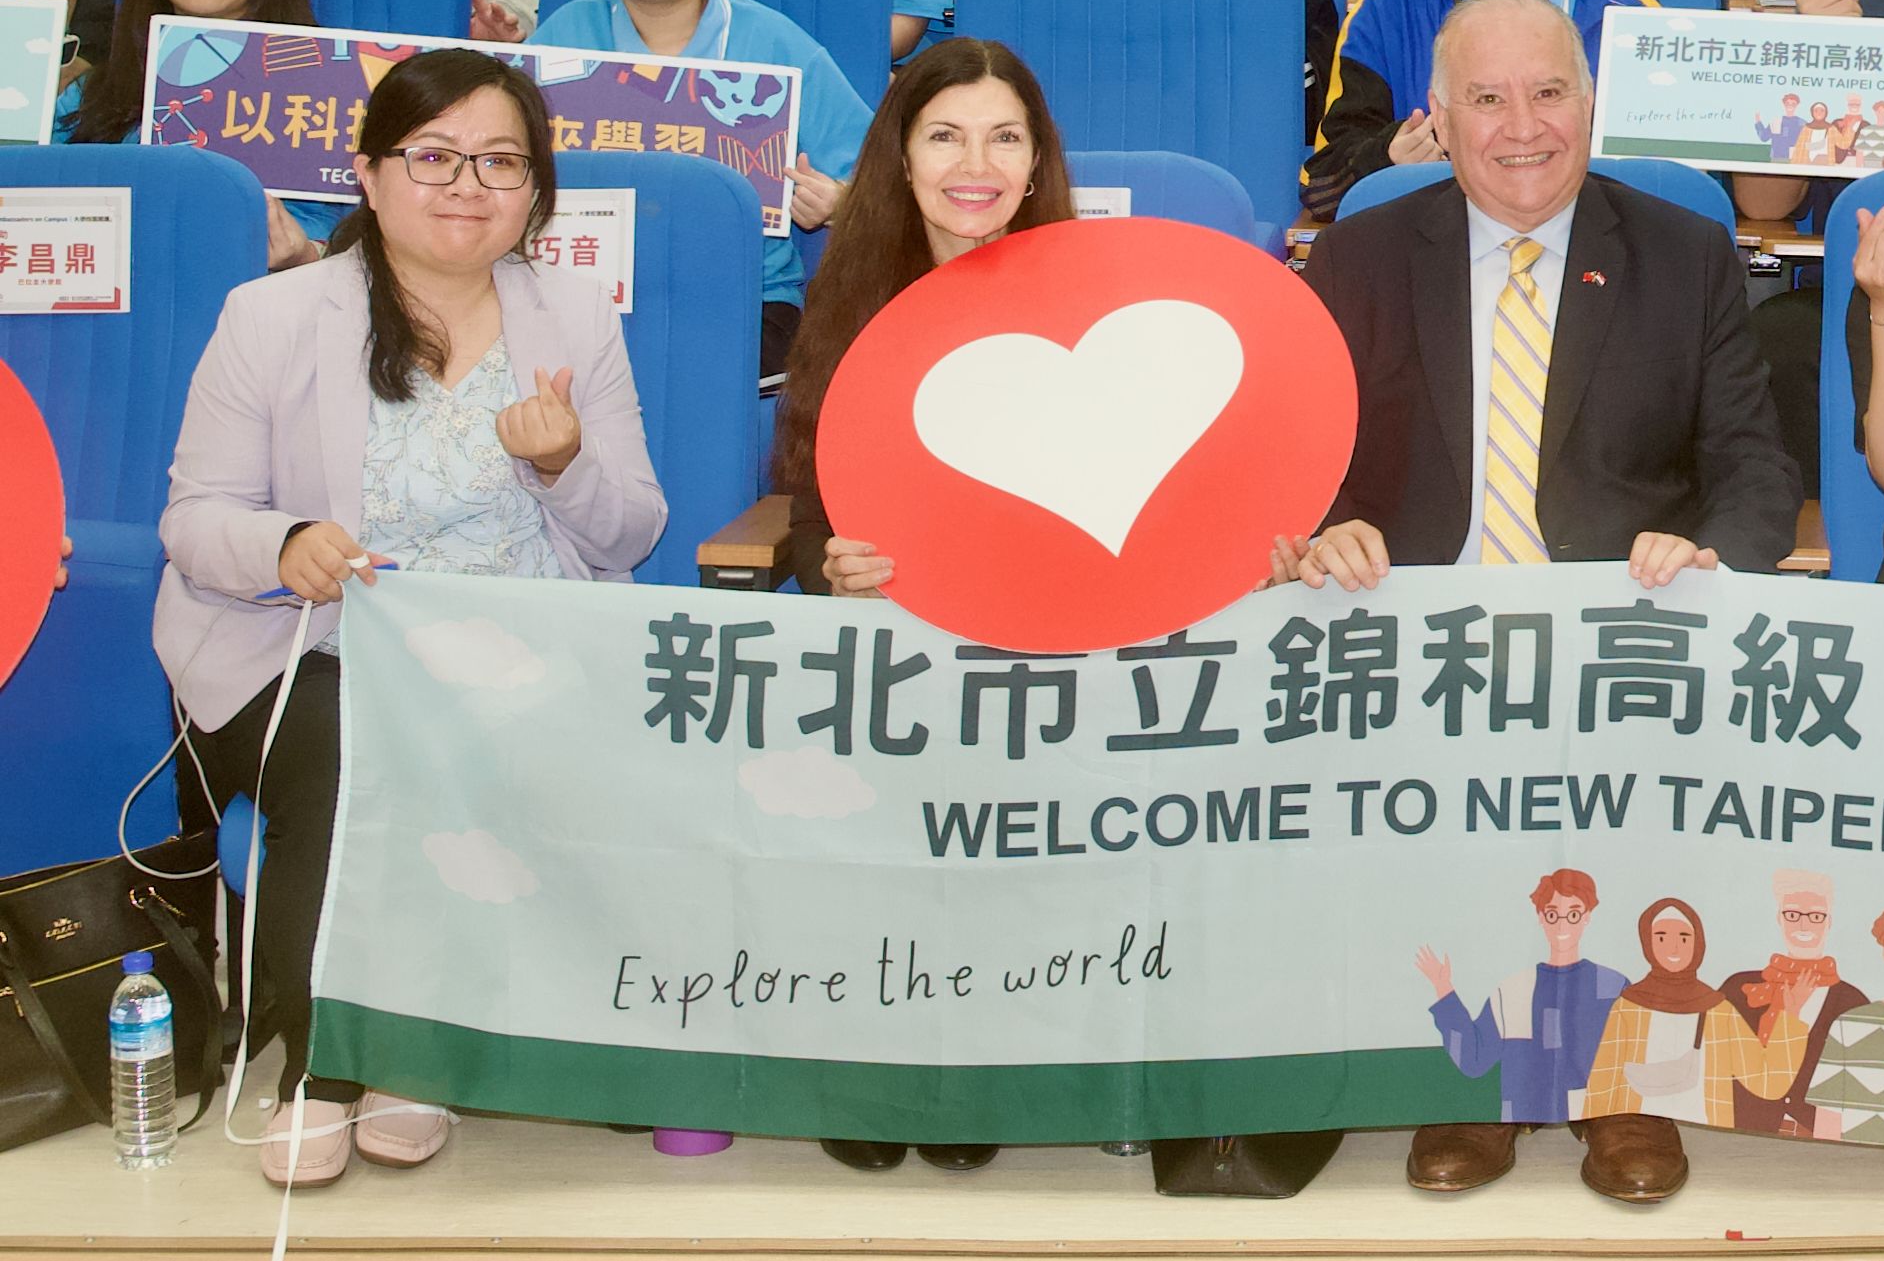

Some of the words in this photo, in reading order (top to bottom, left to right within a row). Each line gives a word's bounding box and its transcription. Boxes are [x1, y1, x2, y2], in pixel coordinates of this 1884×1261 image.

[1692, 71, 1763, 85] WELCOME
[1768, 74, 1787, 86] TO
[1792, 75, 1823, 88] NEW
[1828, 77, 1872, 90] TAIPEI
[1626, 107, 1672, 124] Explore
[1676, 108, 1696, 121] the
[1699, 107, 1733, 121] world
[0, 243, 95, 274] 李昌鼎
[530, 235, 600, 267] 巧音
[922, 783, 1312, 858] WELCOME
[1336, 778, 1437, 837] TO
[1466, 773, 1637, 833] NEW
[613, 949, 847, 1029] Explore
[877, 936, 973, 1006] the
[1003, 920, 1172, 987] world
